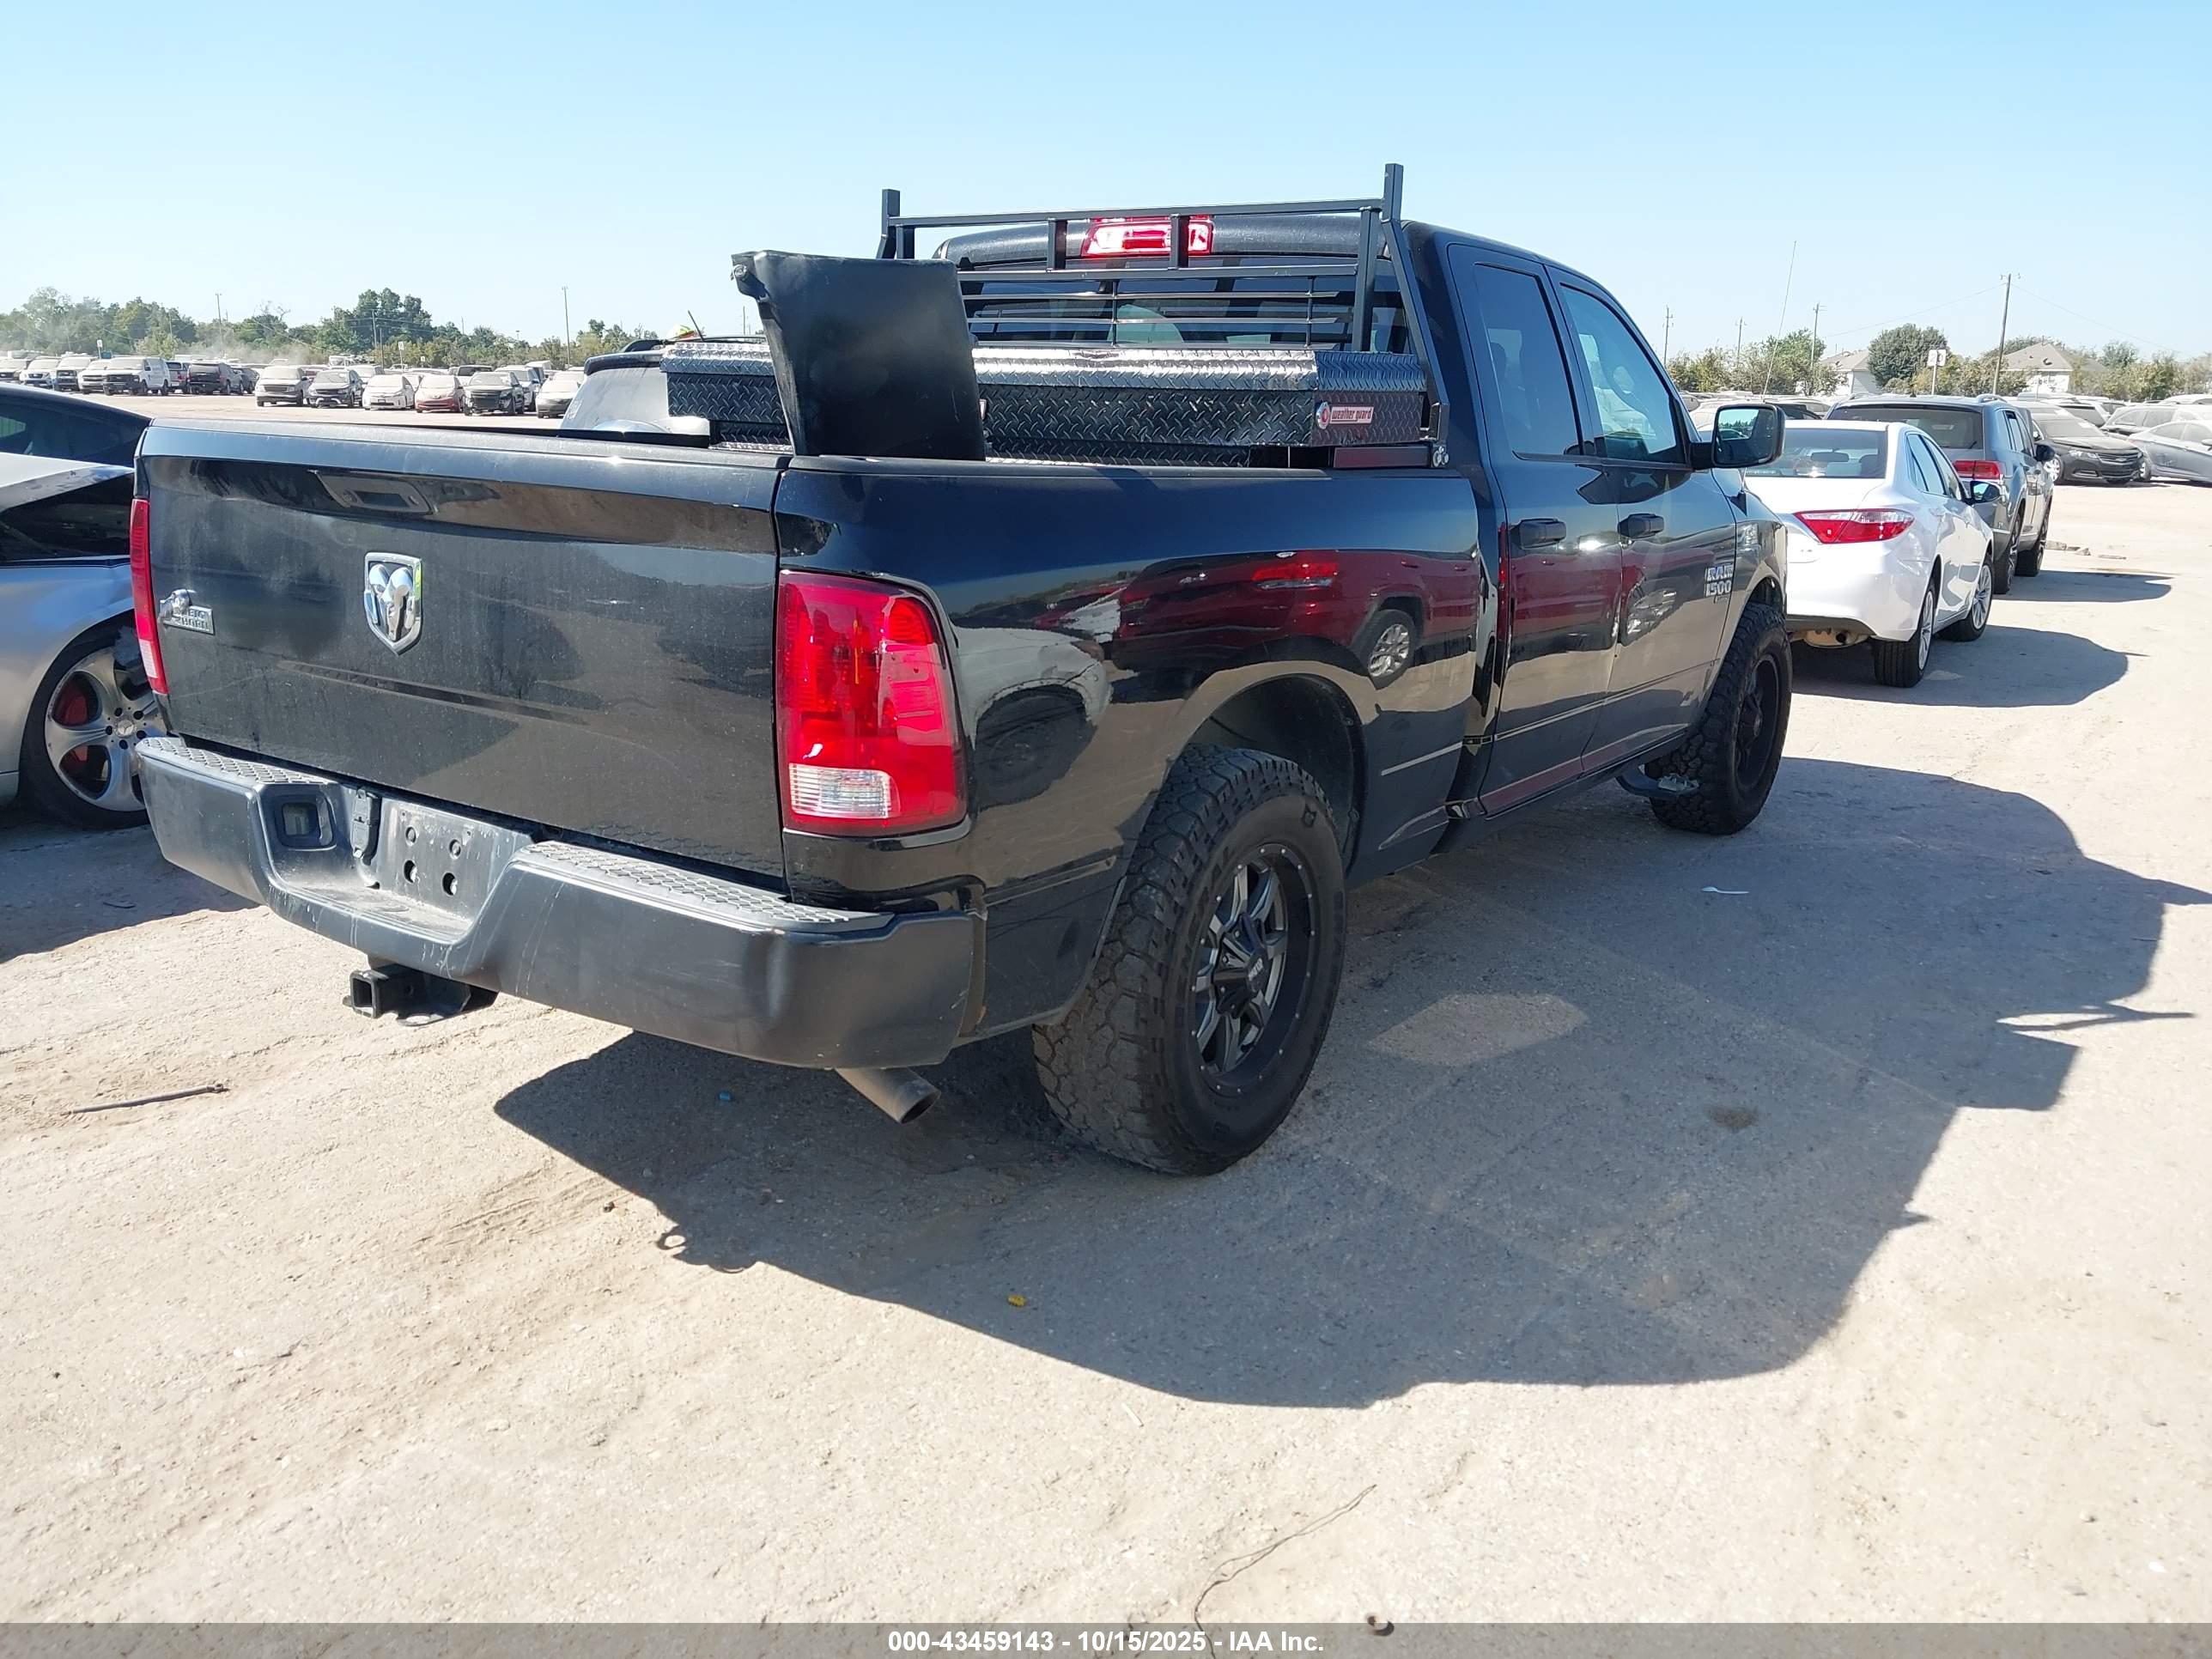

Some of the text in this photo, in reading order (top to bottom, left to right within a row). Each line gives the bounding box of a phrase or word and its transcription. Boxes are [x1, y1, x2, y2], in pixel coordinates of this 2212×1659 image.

[1332, 408, 1371, 420] weather guard
[1706, 565, 1733, 581] RAM
[1705, 580, 1732, 597] 1500
